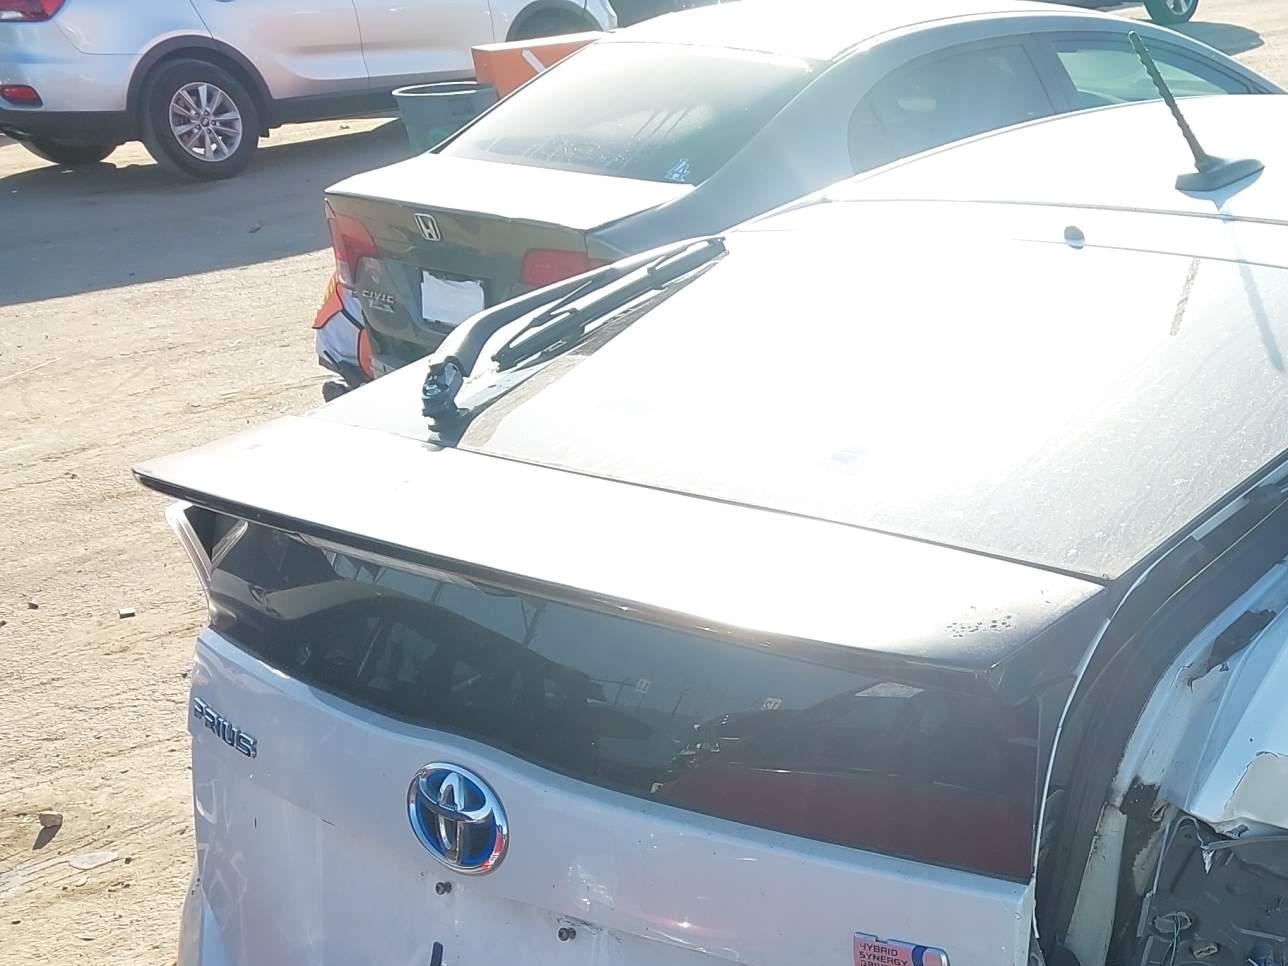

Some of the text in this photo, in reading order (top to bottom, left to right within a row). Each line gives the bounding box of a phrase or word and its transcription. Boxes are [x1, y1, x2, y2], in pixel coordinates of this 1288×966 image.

[361, 289, 394, 304] CIVIC
[193, 696, 257, 758] PRIUS
[859, 943, 898, 957] HYBRID
[859, 950, 908, 966] SYNERGY
